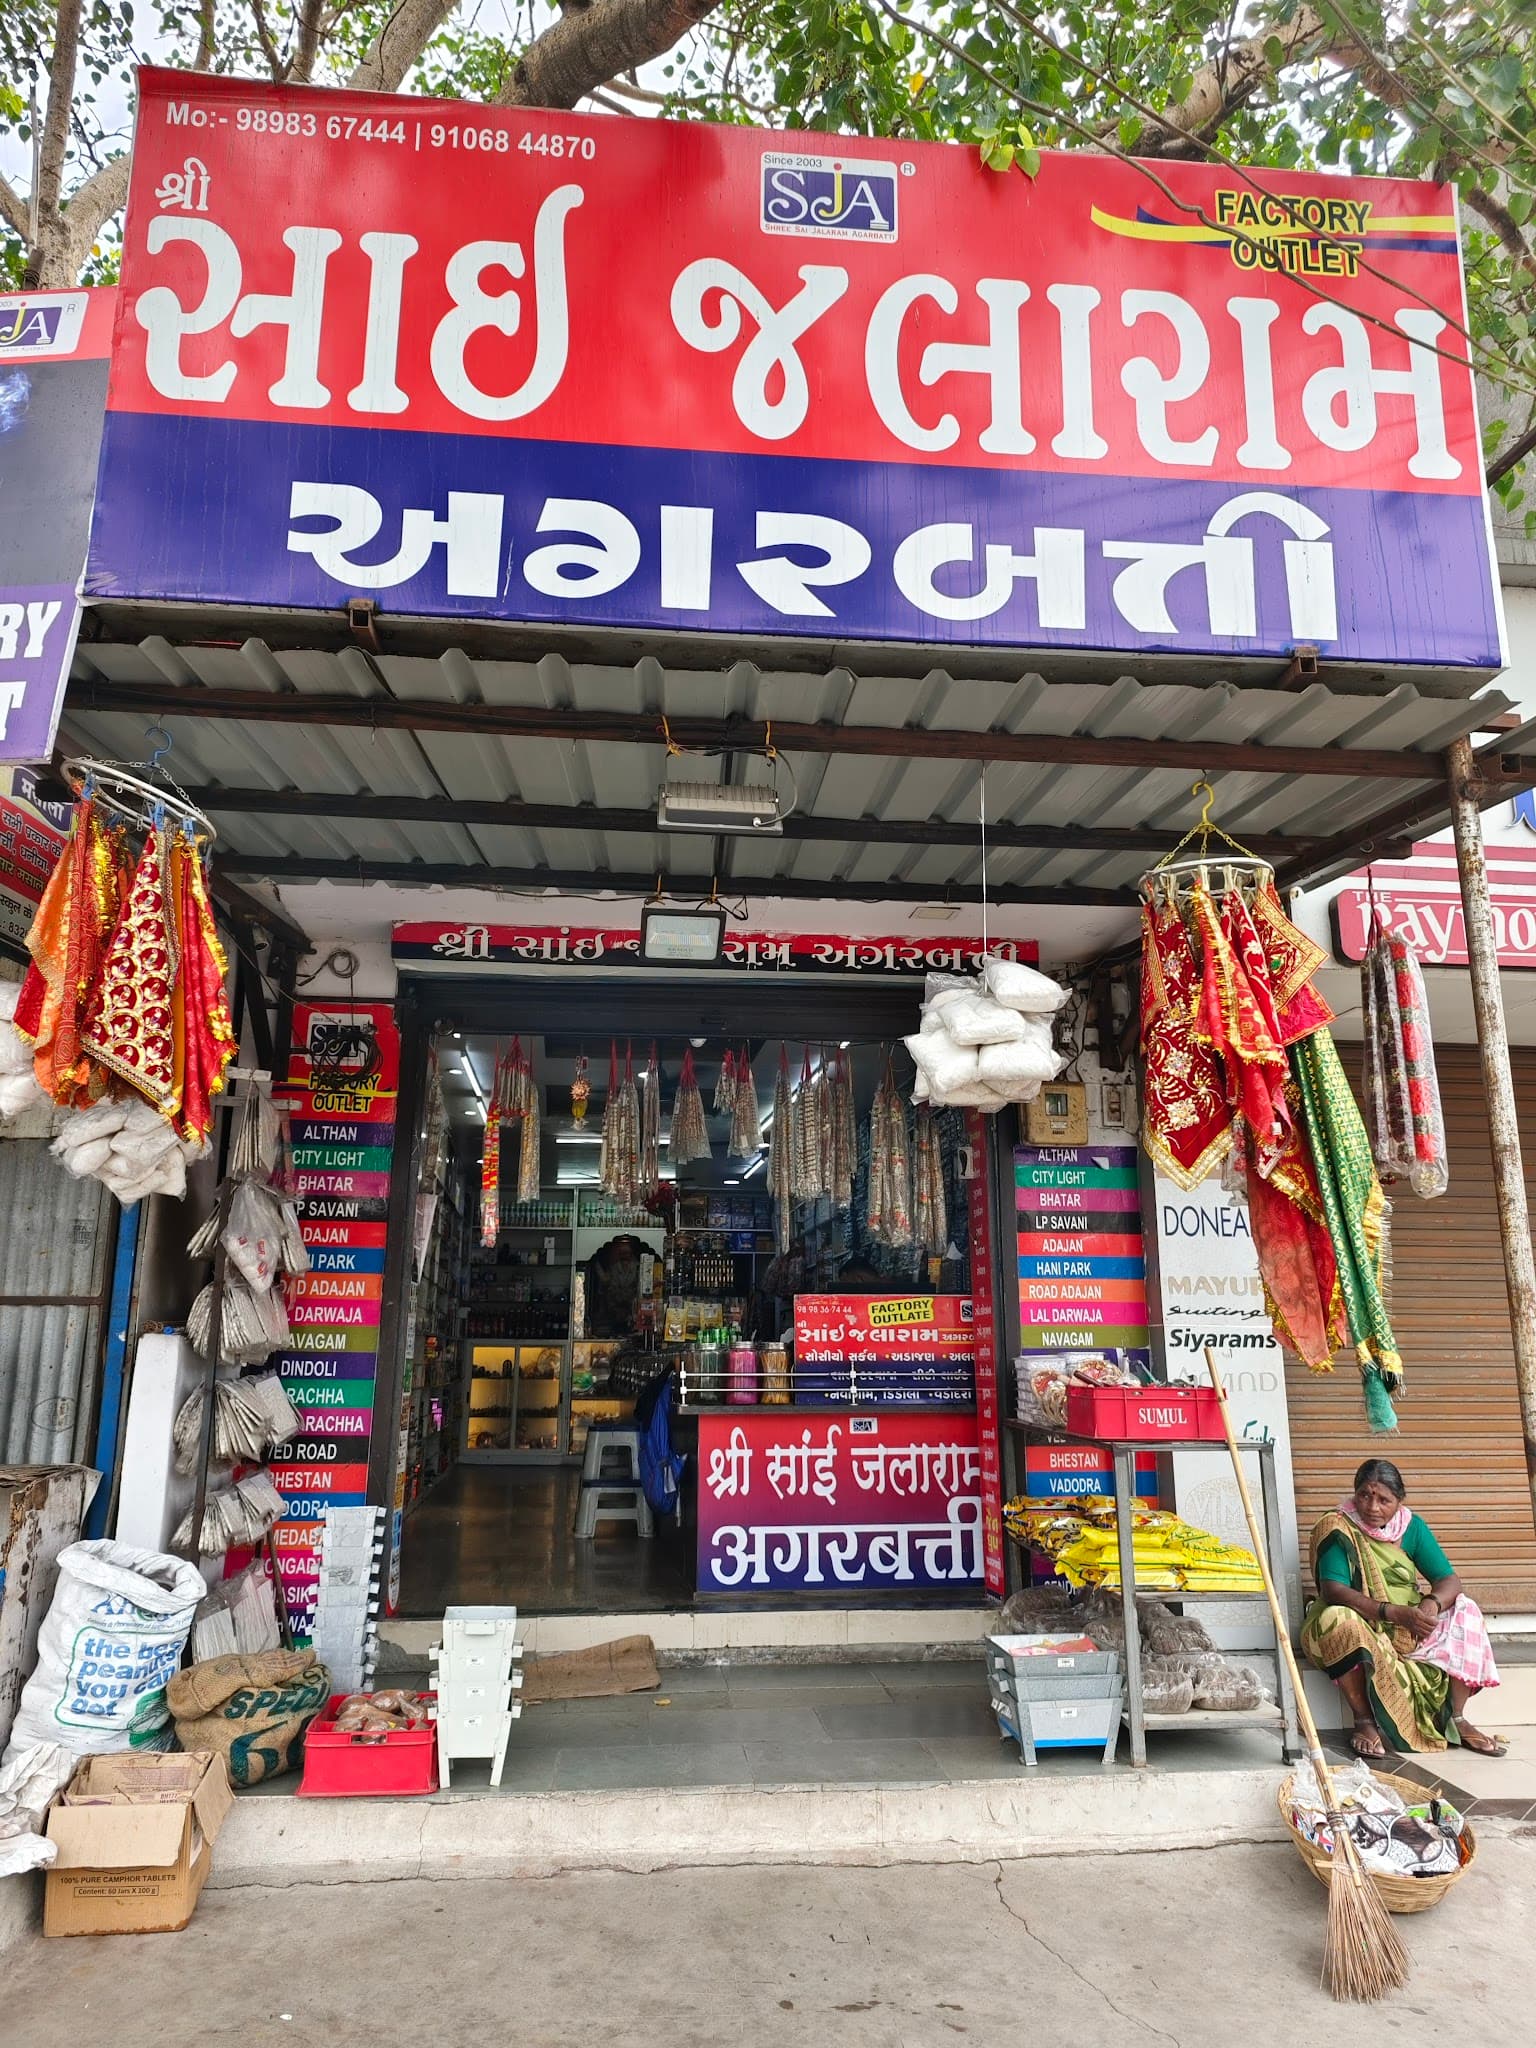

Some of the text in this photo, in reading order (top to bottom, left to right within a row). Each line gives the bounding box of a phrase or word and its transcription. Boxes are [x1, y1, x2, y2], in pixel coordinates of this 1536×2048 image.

[236, 108, 317, 137] 98983
[326, 116, 406, 144] 67444
[430, 124, 510, 153] 91068
[517, 131, 596, 160] 44870
[764, 154, 823, 168] Since 2003
[1217, 191, 1371, 234] FACTORY
[1232, 237, 1362, 277] OUTLET
[671, 257, 1463, 480] જલારામ
[1352, 891, 1392, 903] THE
[313, 1094, 373, 1112] OUTLET
[303, 1125, 358, 1141] ALTHAN
[291, 1150, 365, 1167] CITY LIGHT
[1038, 1149, 1078, 1163] ALTHAN
[298, 1176, 354, 1192] BHATAR
[1032, 1171, 1086, 1185] CITY LIGHT
[1039, 1193, 1081, 1207] BHATAR
[308, 1202, 359, 1218] SAVANI
[1035, 1216, 1088, 1230] LP SAVANI
[1164, 1206, 1252, 1238] DONEA
[302, 1227, 349, 1243] DAJAN
[1042, 1239, 1083, 1252] ADAJAN
[318, 1254, 356, 1270] PARK
[1036, 1262, 1092, 1276] HANI PARK
[309, 1280, 365, 1297] ADAJAN
[1029, 1285, 1102, 1299] ROAD ADAJAN
[294, 1306, 363, 1323] DARWAJA
[871, 1299, 930, 1314] FACTORY
[872, 1310, 931, 1324] OUTLATE
[1030, 1309, 1103, 1323] LAL DARWAJA
[288, 1332, 347, 1350] AVAGAM
[1041, 1332, 1094, 1346] NAVAGAM
[1169, 1328, 1277, 1353] Siyarams
[280, 1360, 337, 1376] DINDOLI
[1138, 1407, 1187, 1425] SUMUL
[296, 1444, 337, 1460] ROAD
[706, 1427, 753, 1499] श्री
[1050, 1453, 1099, 1468] BHESTAN
[1050, 1478, 1101, 1493] VADODRA
[710, 1496, 985, 1586] अगरबत्ती
[84, 1638, 131, 1659] the
[76, 1665, 176, 1699] you can
[80, 1875, 101, 1884] PURE
[103, 1875, 142, 1884] CAMPHOR
[142, 1874, 177, 1883] TABLETS
